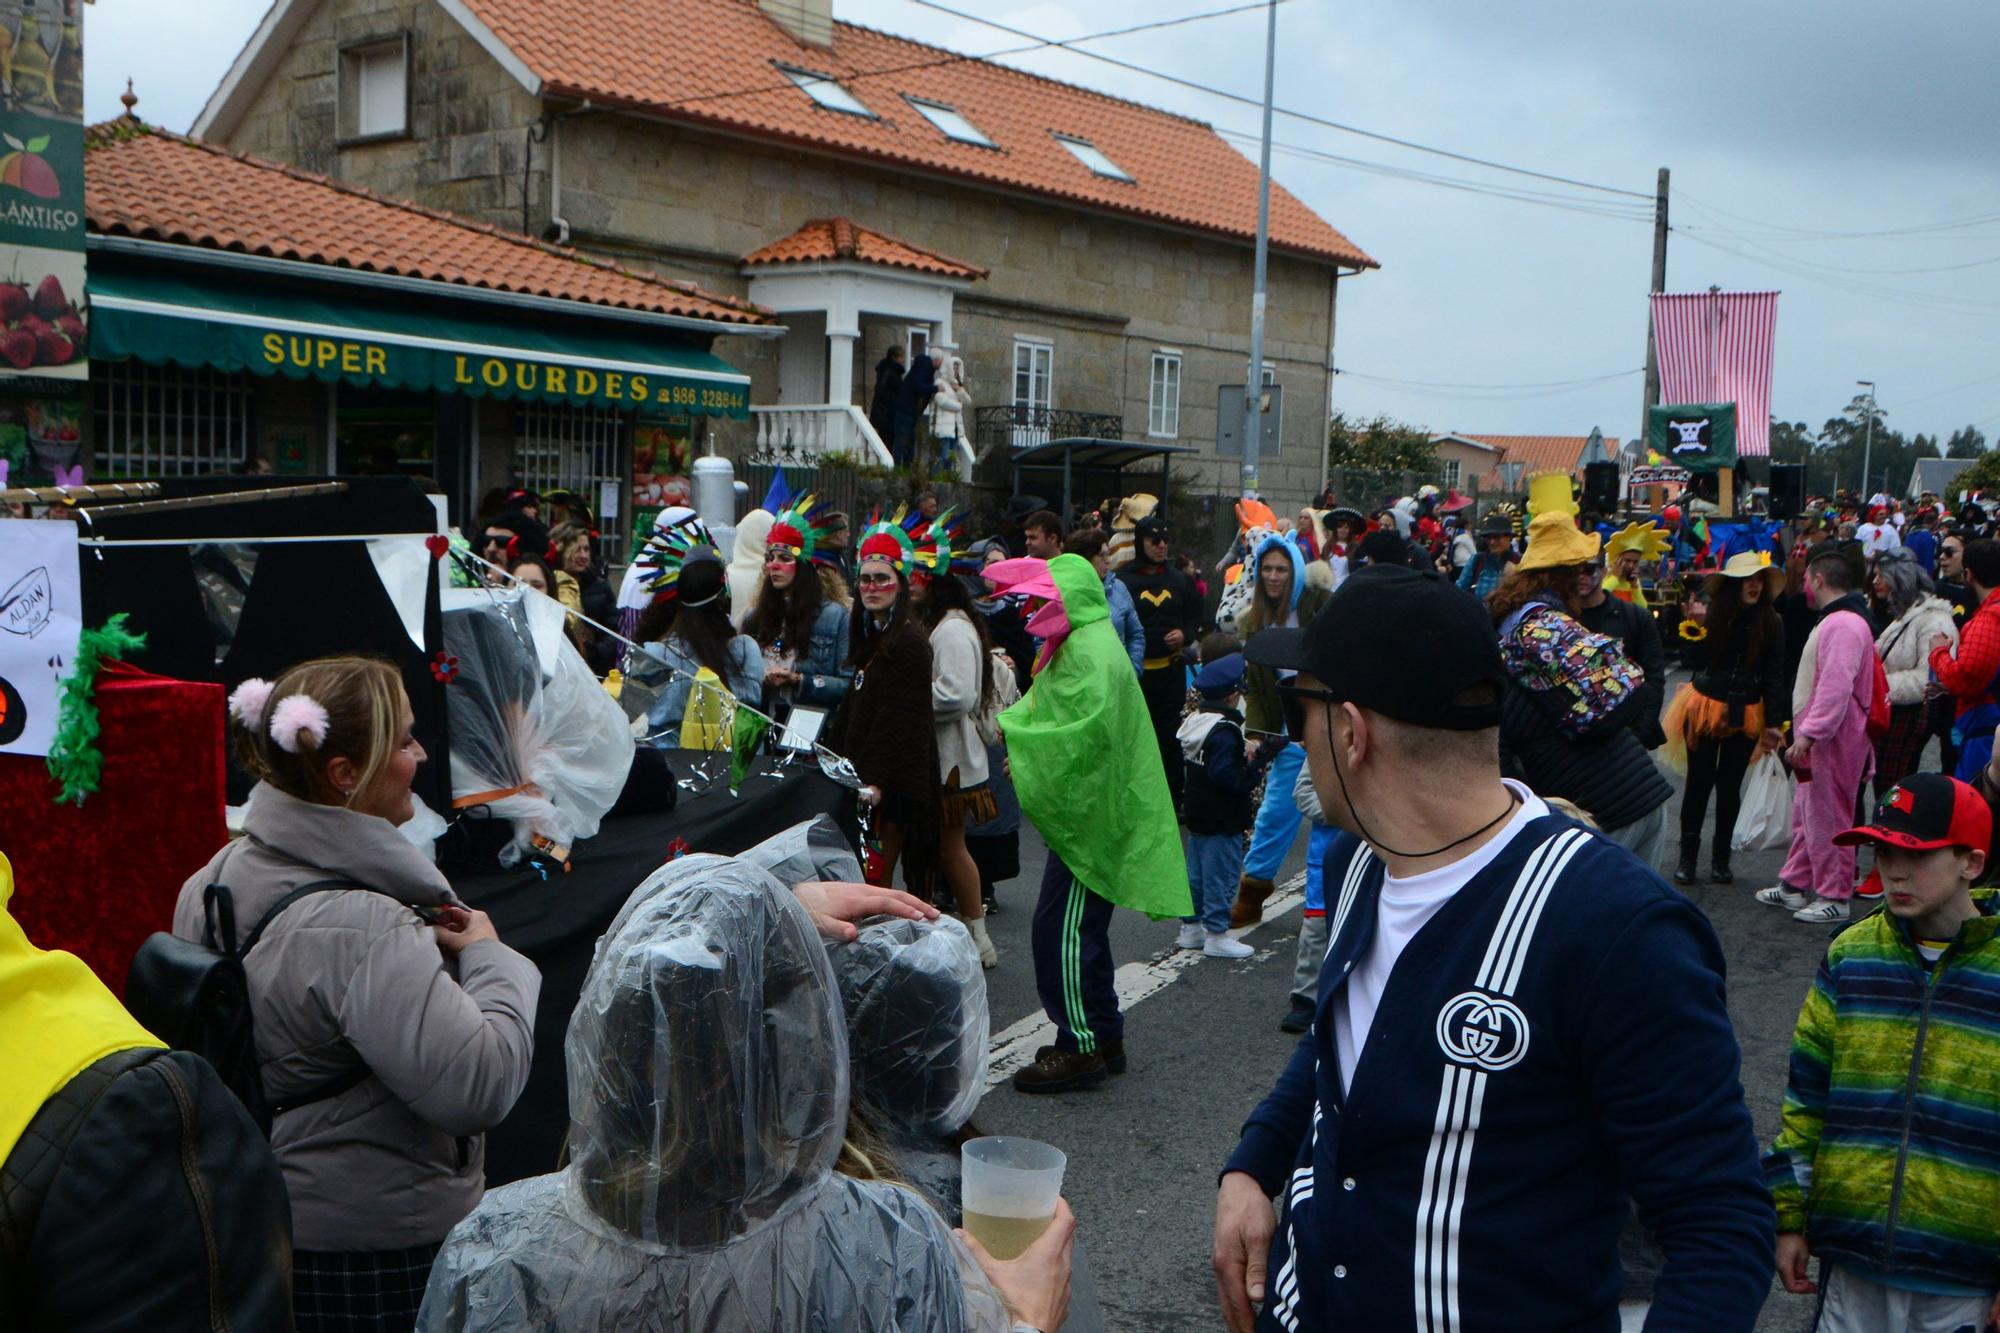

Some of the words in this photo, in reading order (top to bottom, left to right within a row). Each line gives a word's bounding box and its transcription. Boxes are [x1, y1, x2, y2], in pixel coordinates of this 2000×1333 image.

[263, 333, 387, 375] SUPER
[455, 355, 649, 401] LOURDES
[673, 386, 696, 405] 986
[701, 389, 744, 408] 328844
